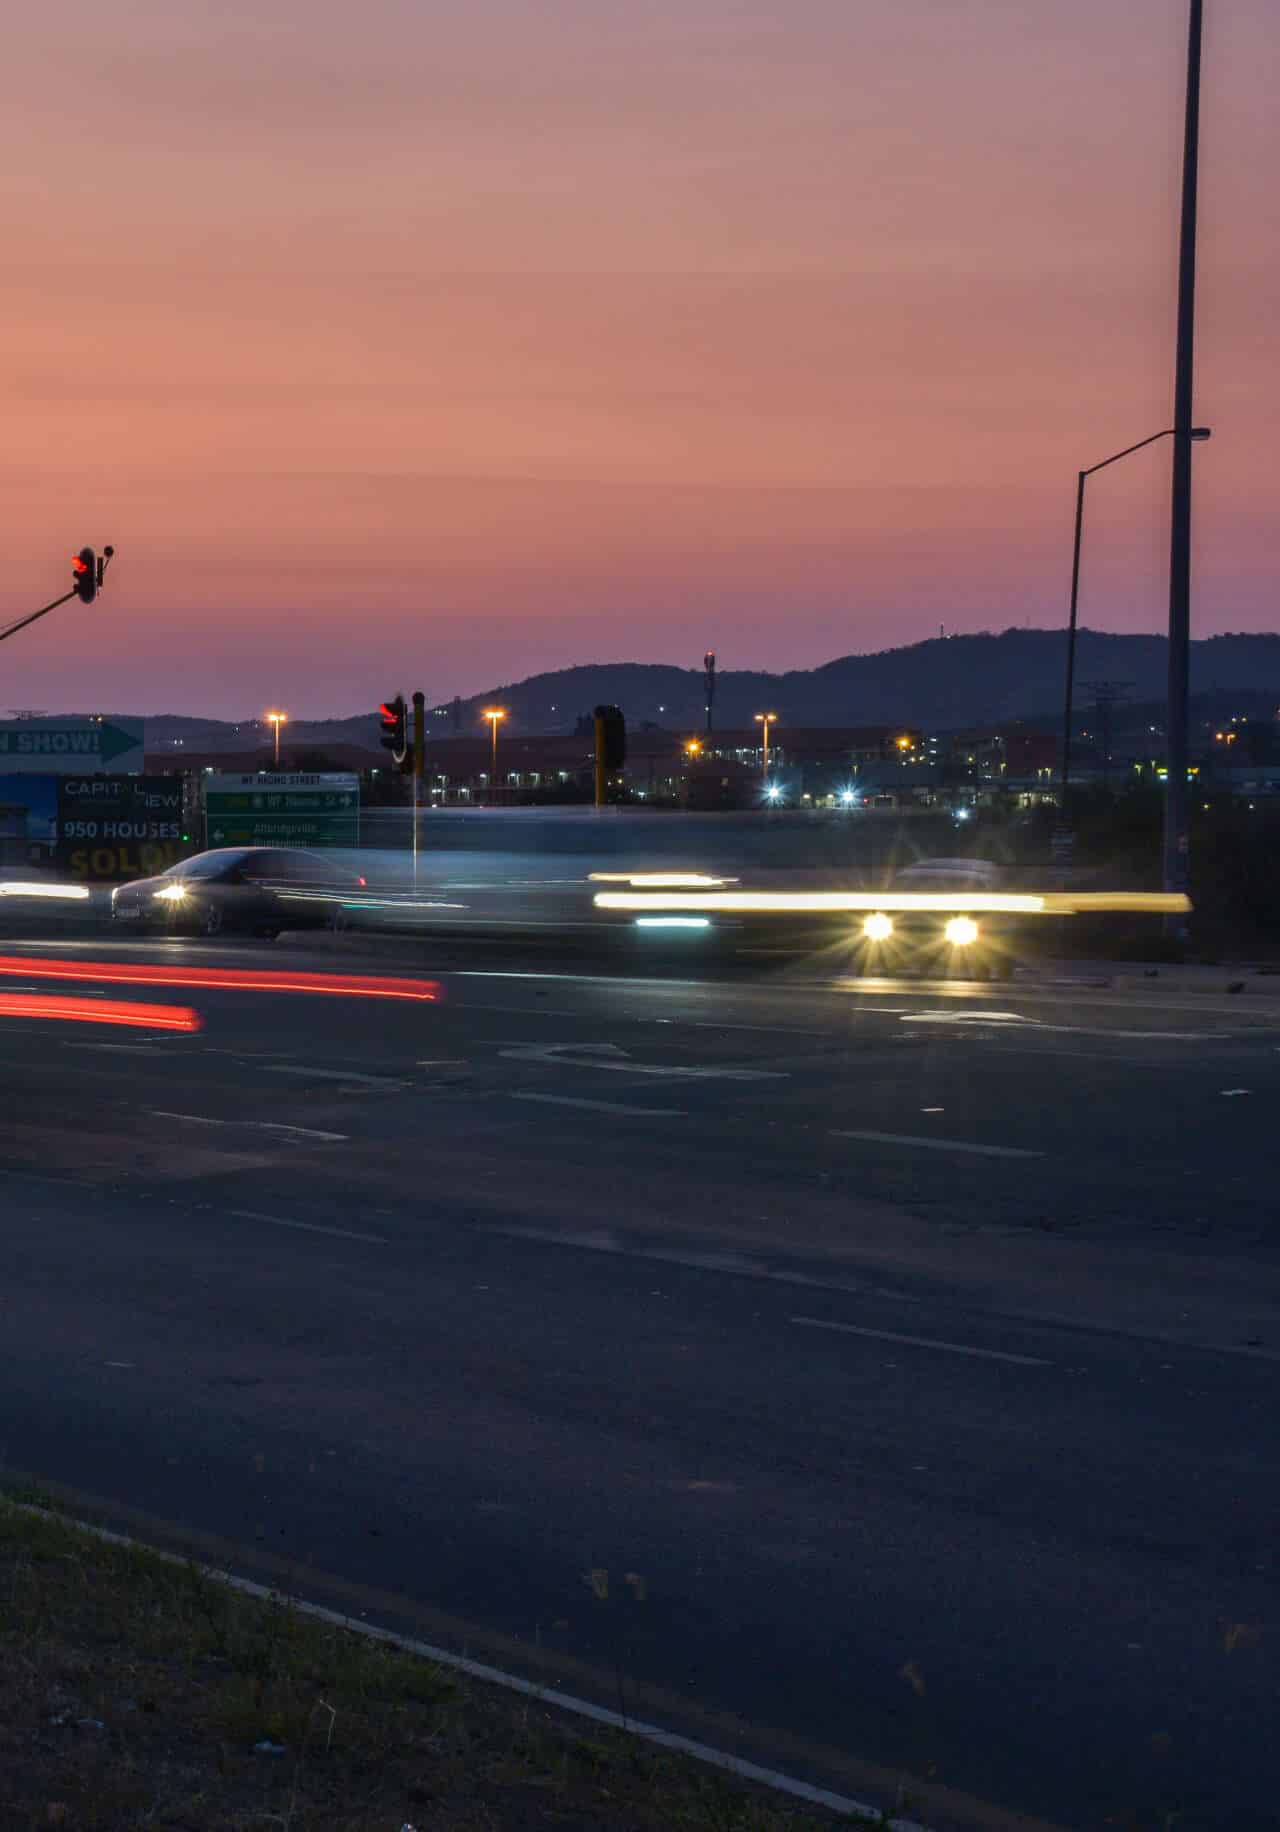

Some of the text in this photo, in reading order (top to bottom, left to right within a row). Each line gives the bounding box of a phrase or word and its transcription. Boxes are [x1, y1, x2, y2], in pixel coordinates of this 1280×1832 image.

[16, 731, 101, 752] SHOW!
[64, 820, 179, 840] 950 HOUSES
